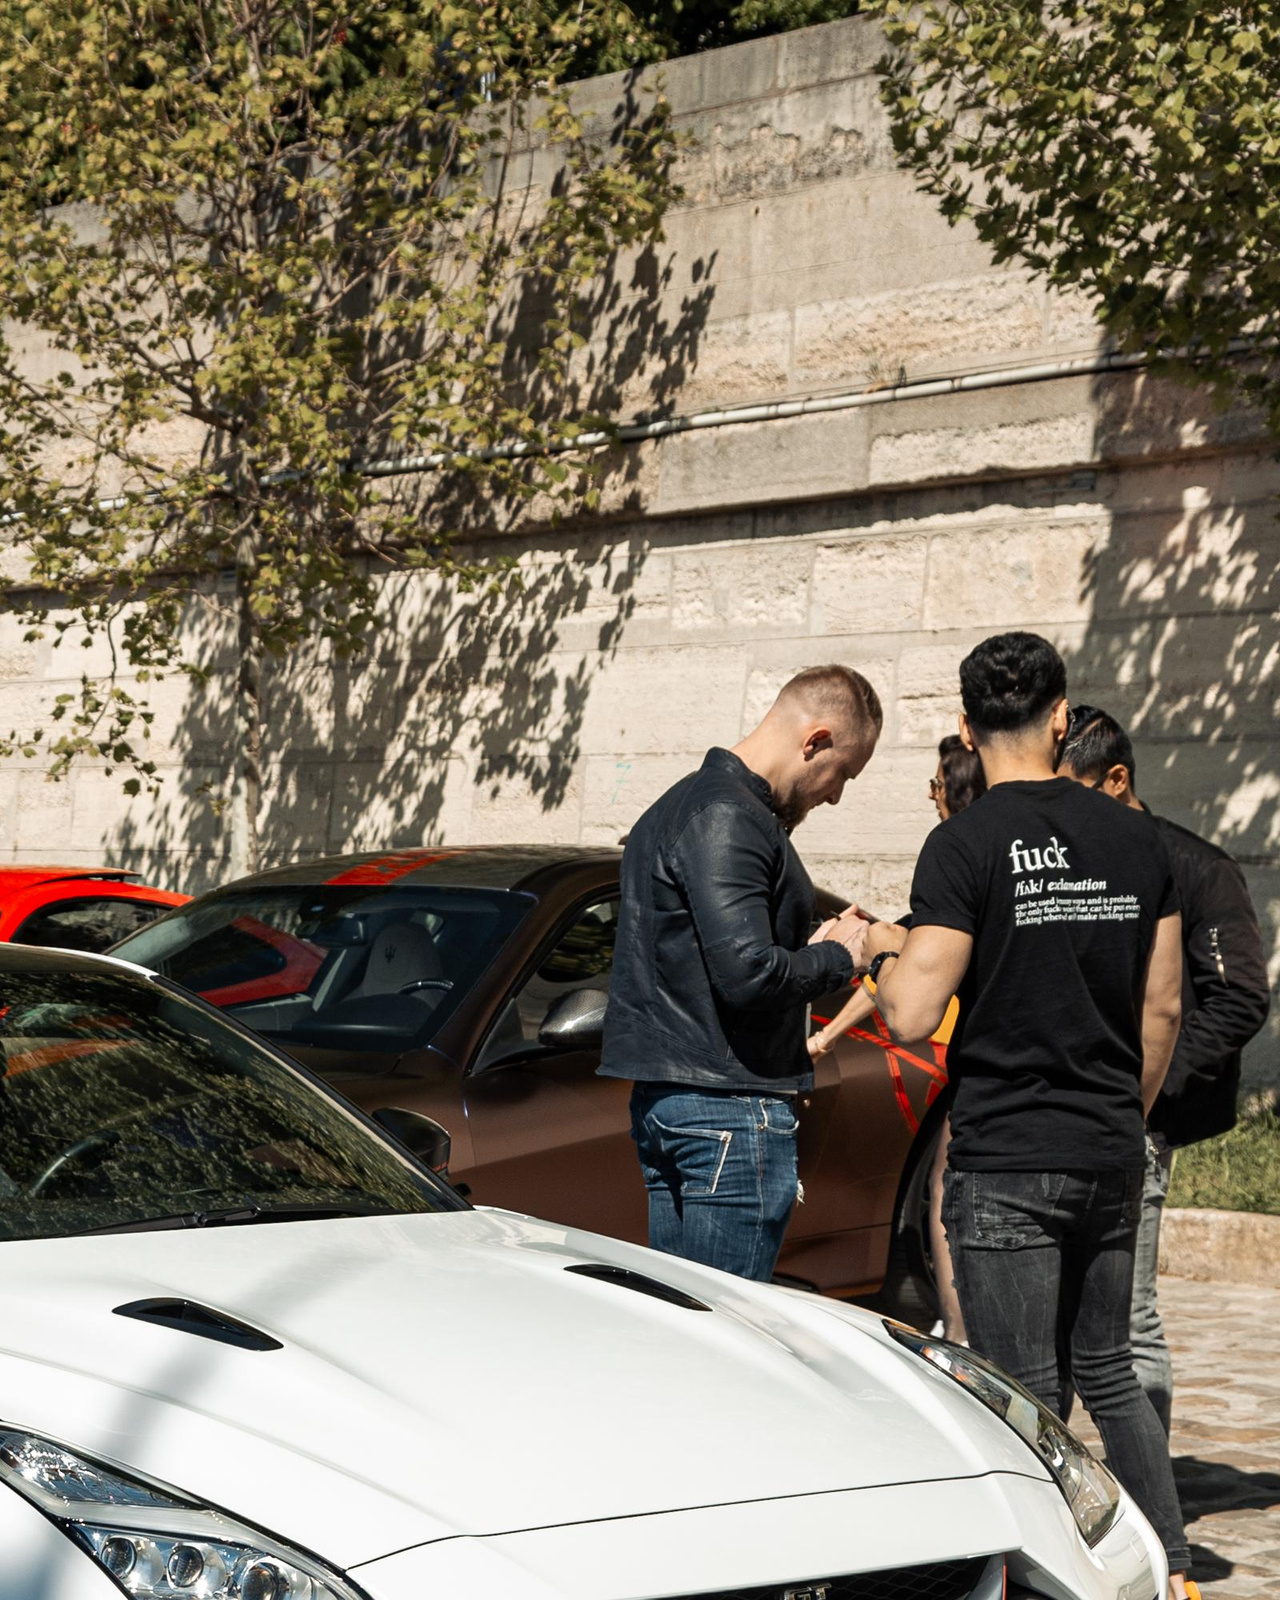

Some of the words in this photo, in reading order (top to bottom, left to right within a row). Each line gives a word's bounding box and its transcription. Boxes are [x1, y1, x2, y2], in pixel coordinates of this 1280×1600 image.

[1009, 836, 1071, 874] fuck
[1028, 900, 1038, 909] be
[1038, 896, 1056, 907] used
[1087, 895, 1102, 905] and
[1109, 894, 1139, 905] probably
[1027, 906, 1043, 917] only
[1103, 903, 1113, 912] be
[1077, 912, 1098, 921] make
